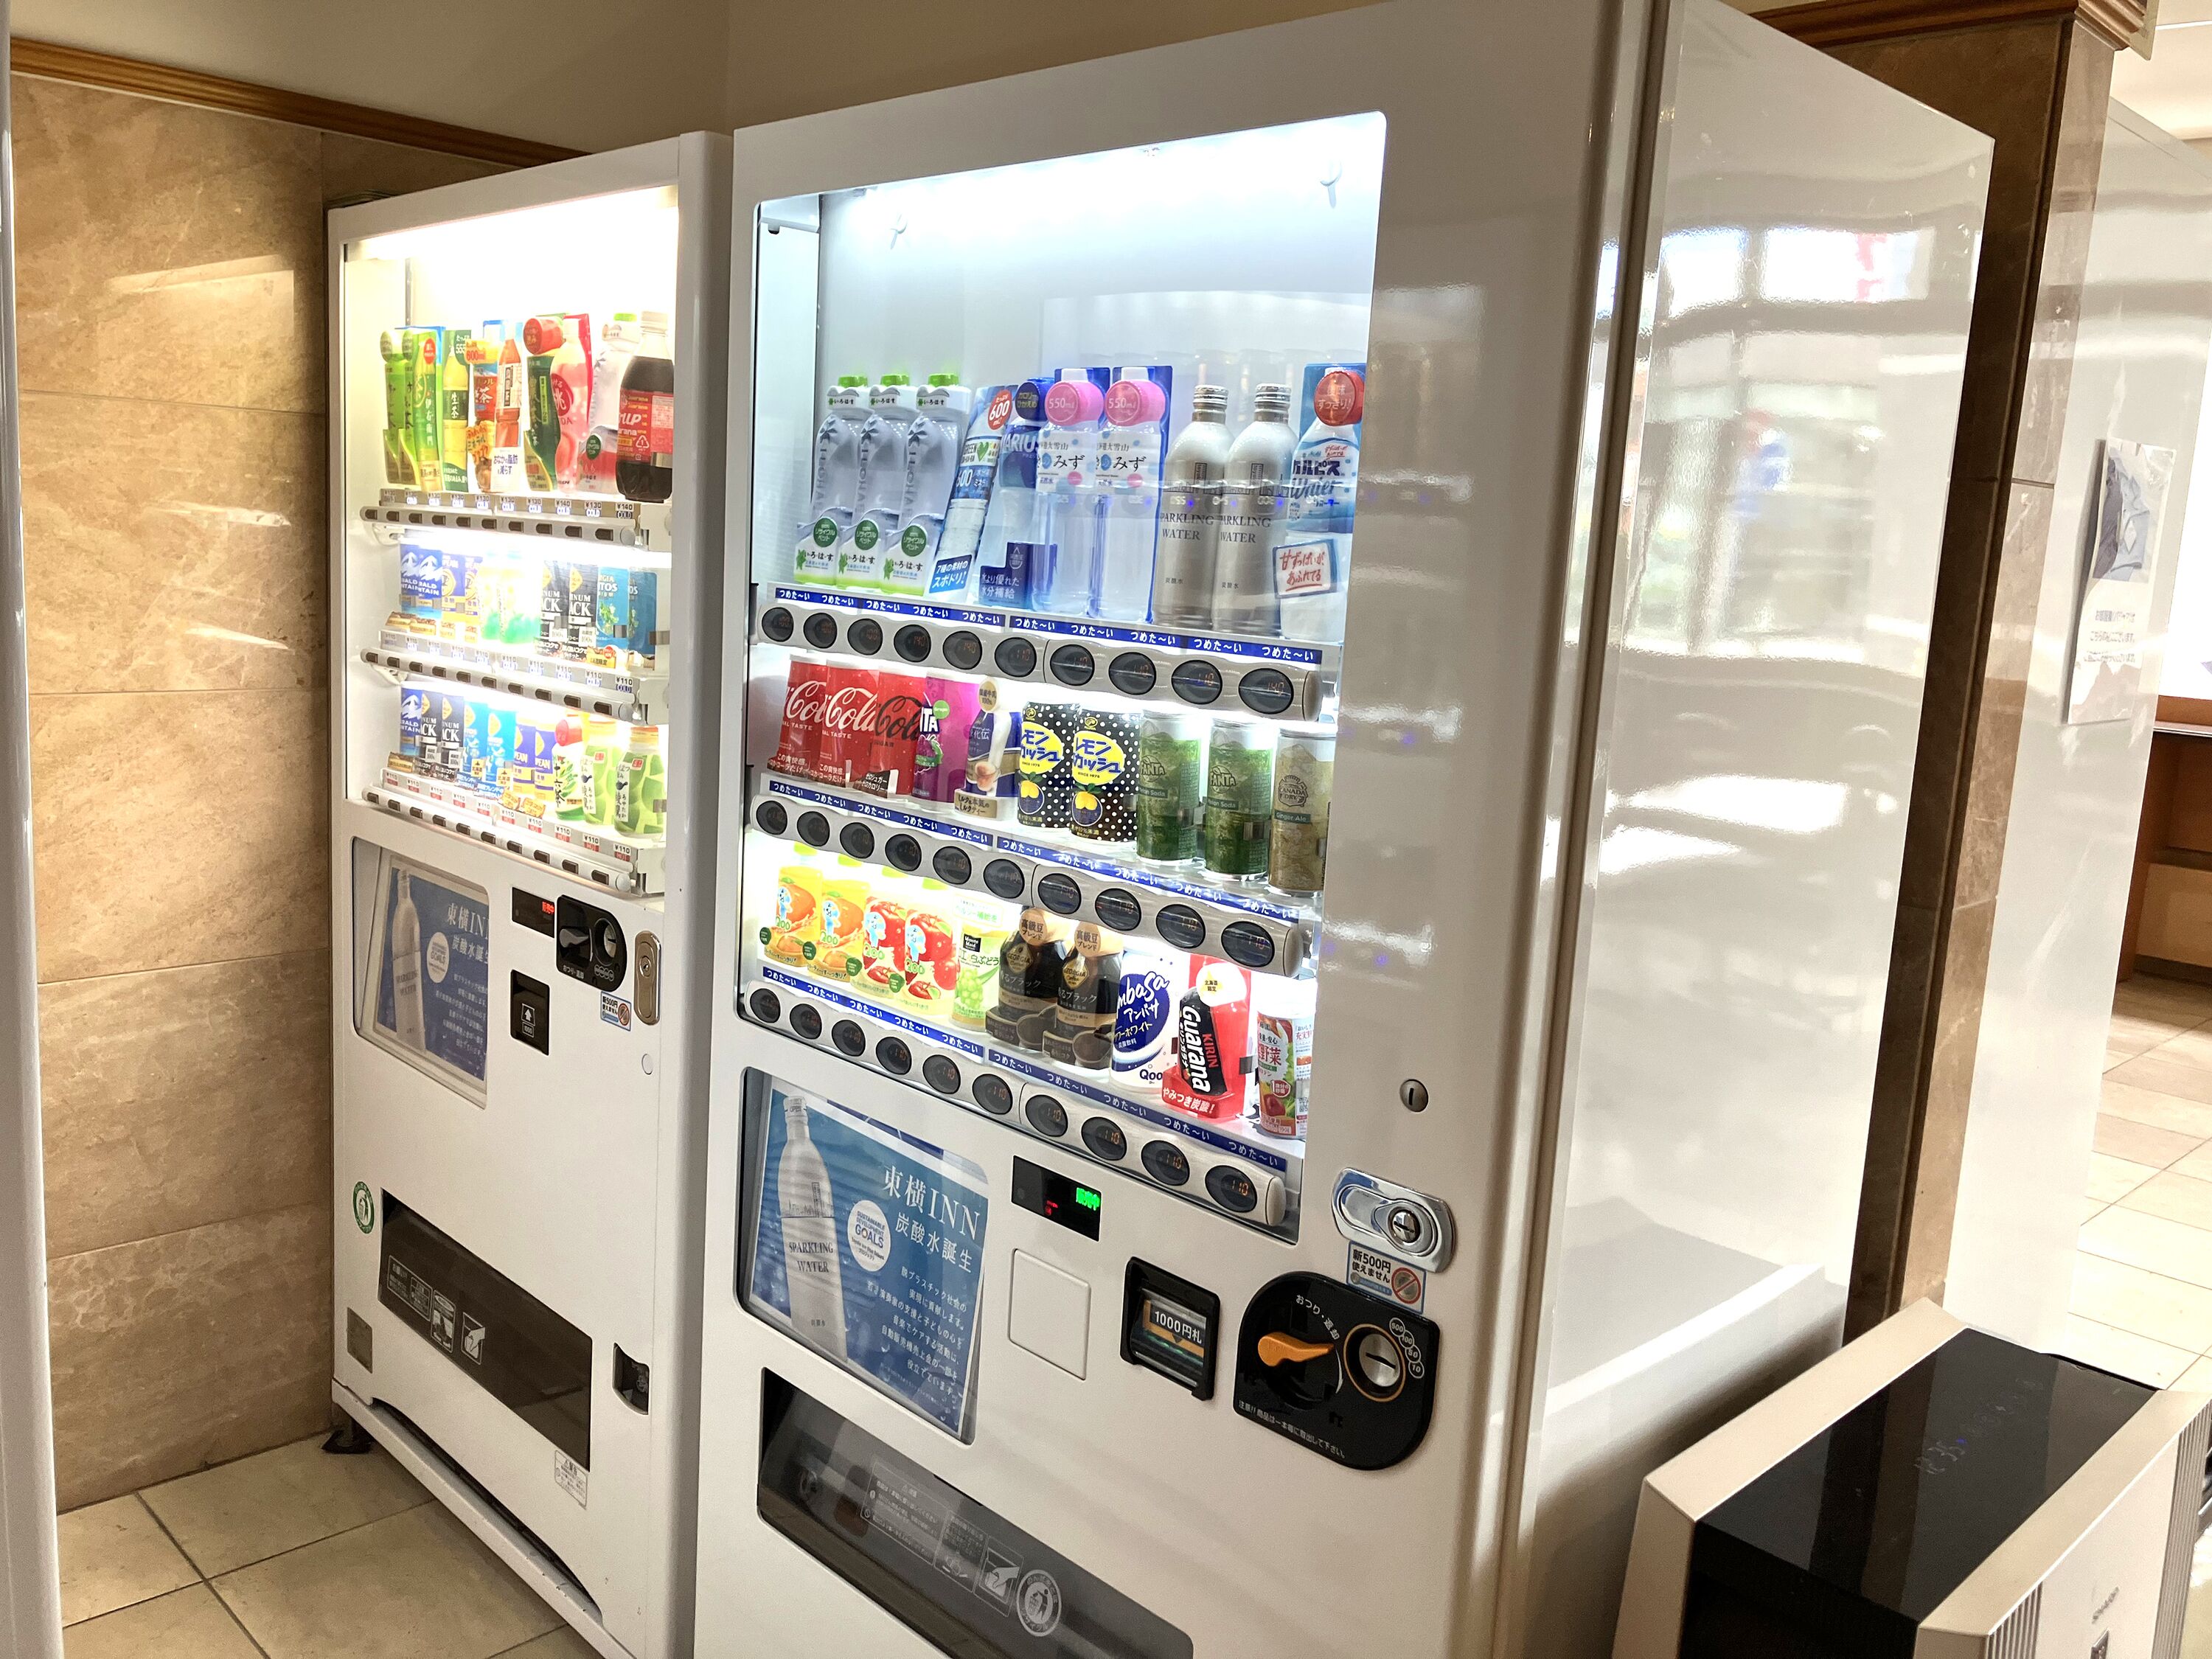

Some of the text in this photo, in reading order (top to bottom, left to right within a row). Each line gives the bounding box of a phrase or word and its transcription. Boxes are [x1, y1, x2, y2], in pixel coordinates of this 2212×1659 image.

[990, 400, 1010, 420] 600
[1162, 529, 1200, 540] WATER
[1220, 531, 1256, 543] WATER
[616, 677, 633, 686] ¥110
[790, 723, 813, 731] TASTE
[1023, 729, 1049, 745] モン
[1020, 745, 1062, 762] カッシュ
[1077, 737, 1112, 756] レモン
[1074, 754, 1121, 773] カッシュ
[1141, 762, 1165, 776] FANTA
[866, 773, 888, 784] ゼロシュガー
[1211, 772, 1236, 787] FANTA
[1150, 789, 1166, 797] Soda
[1279, 786, 1305, 796] CANADA
[1276, 813, 1294, 821] Ginger
[556, 826, 571, 835] ¥110
[584, 835, 599, 844] ¥110
[615, 844, 631, 854] ¥110
[1022, 928, 1043, 941] ブレンド
[1077, 930, 1099, 945] 高級豆
[1078, 941, 1097, 951] ブレンド
[1064, 967, 1086, 979] GEORGIA
[1124, 998, 1160, 1023] アンバサ
[1118, 1038, 1137, 1048] 炭酸飲料
[1180, 1022, 1189, 1069] キリンガラナ
[1183, 1006, 1211, 1093] Guarana
[1202, 1034, 1219, 1068] KIRIN
[1139, 1069, 1162, 1081] Qoo
[1162, 1088, 1215, 1114] やみつき炭酸!
[1104, 1130, 1119, 1144] 110
[1165, 1153, 1183, 1169] 110
[1231, 1180, 1248, 1196] 110
[882, 1165, 981, 1240] 東横INN
[857, 1210, 885, 1228] SUSTAINABLE
[855, 1217, 885, 1237] DEVELOPMENT
[855, 1224, 884, 1249] GOALS
[895, 1211, 973, 1273] 炭酸水誕生
[789, 1240, 833, 1254] SPARKLING
[796, 1259, 830, 1273] WATER
[1352, 1249, 1391, 1274] 新500円
[1352, 1261, 1391, 1283] 使えません
[900, 1266, 967, 1312] 脱プラスチック社会の
[1295, 1294, 1340, 1340] おつり・返却
[1155, 1310, 1202, 1344] 1000円札
[1391, 1322, 1403, 1333] 500
[1401, 1335, 1413, 1345] 100
[1408, 1349, 1419, 1358] 50
[1411, 1364, 1422, 1373] 10
